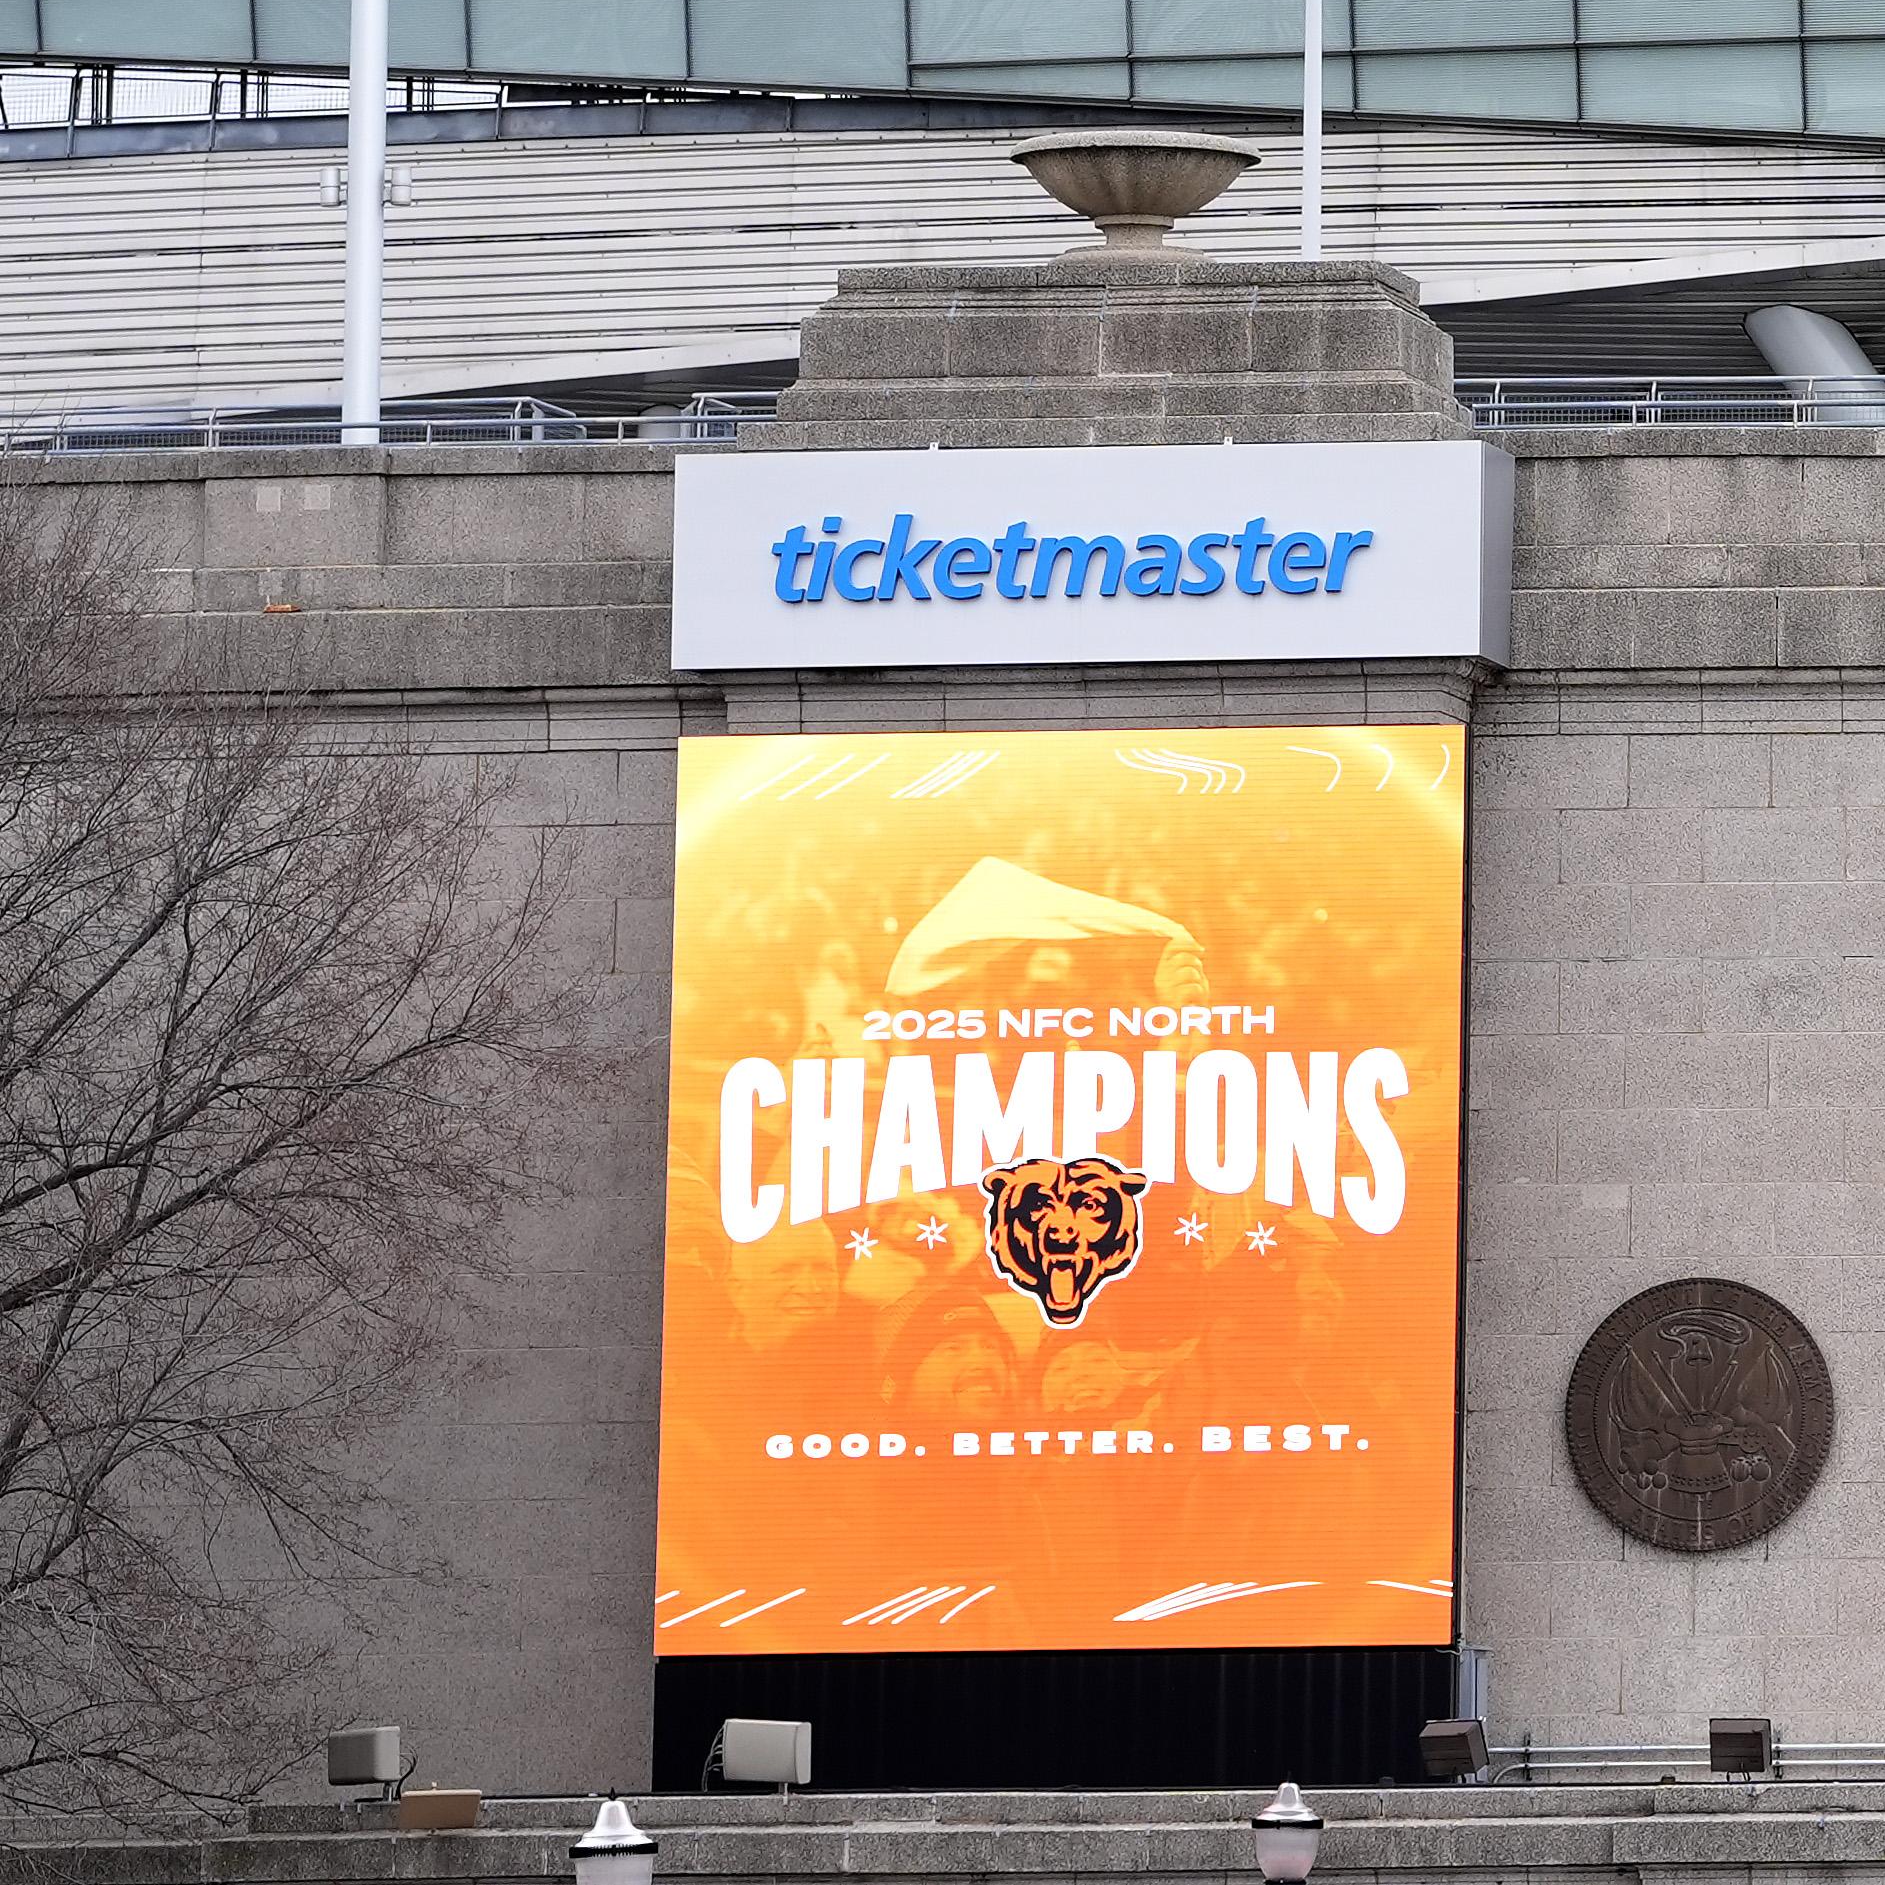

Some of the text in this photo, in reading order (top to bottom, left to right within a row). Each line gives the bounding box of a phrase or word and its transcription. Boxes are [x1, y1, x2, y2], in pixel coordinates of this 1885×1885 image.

[770, 513, 1375, 604] ticketmaster
[861, 1005, 1276, 1042] 2025 NFC NORTH
[719, 1047, 1409, 1244] CHAMPIONS
[765, 1424, 1370, 1460] GOOD. BETTER. BEST.
